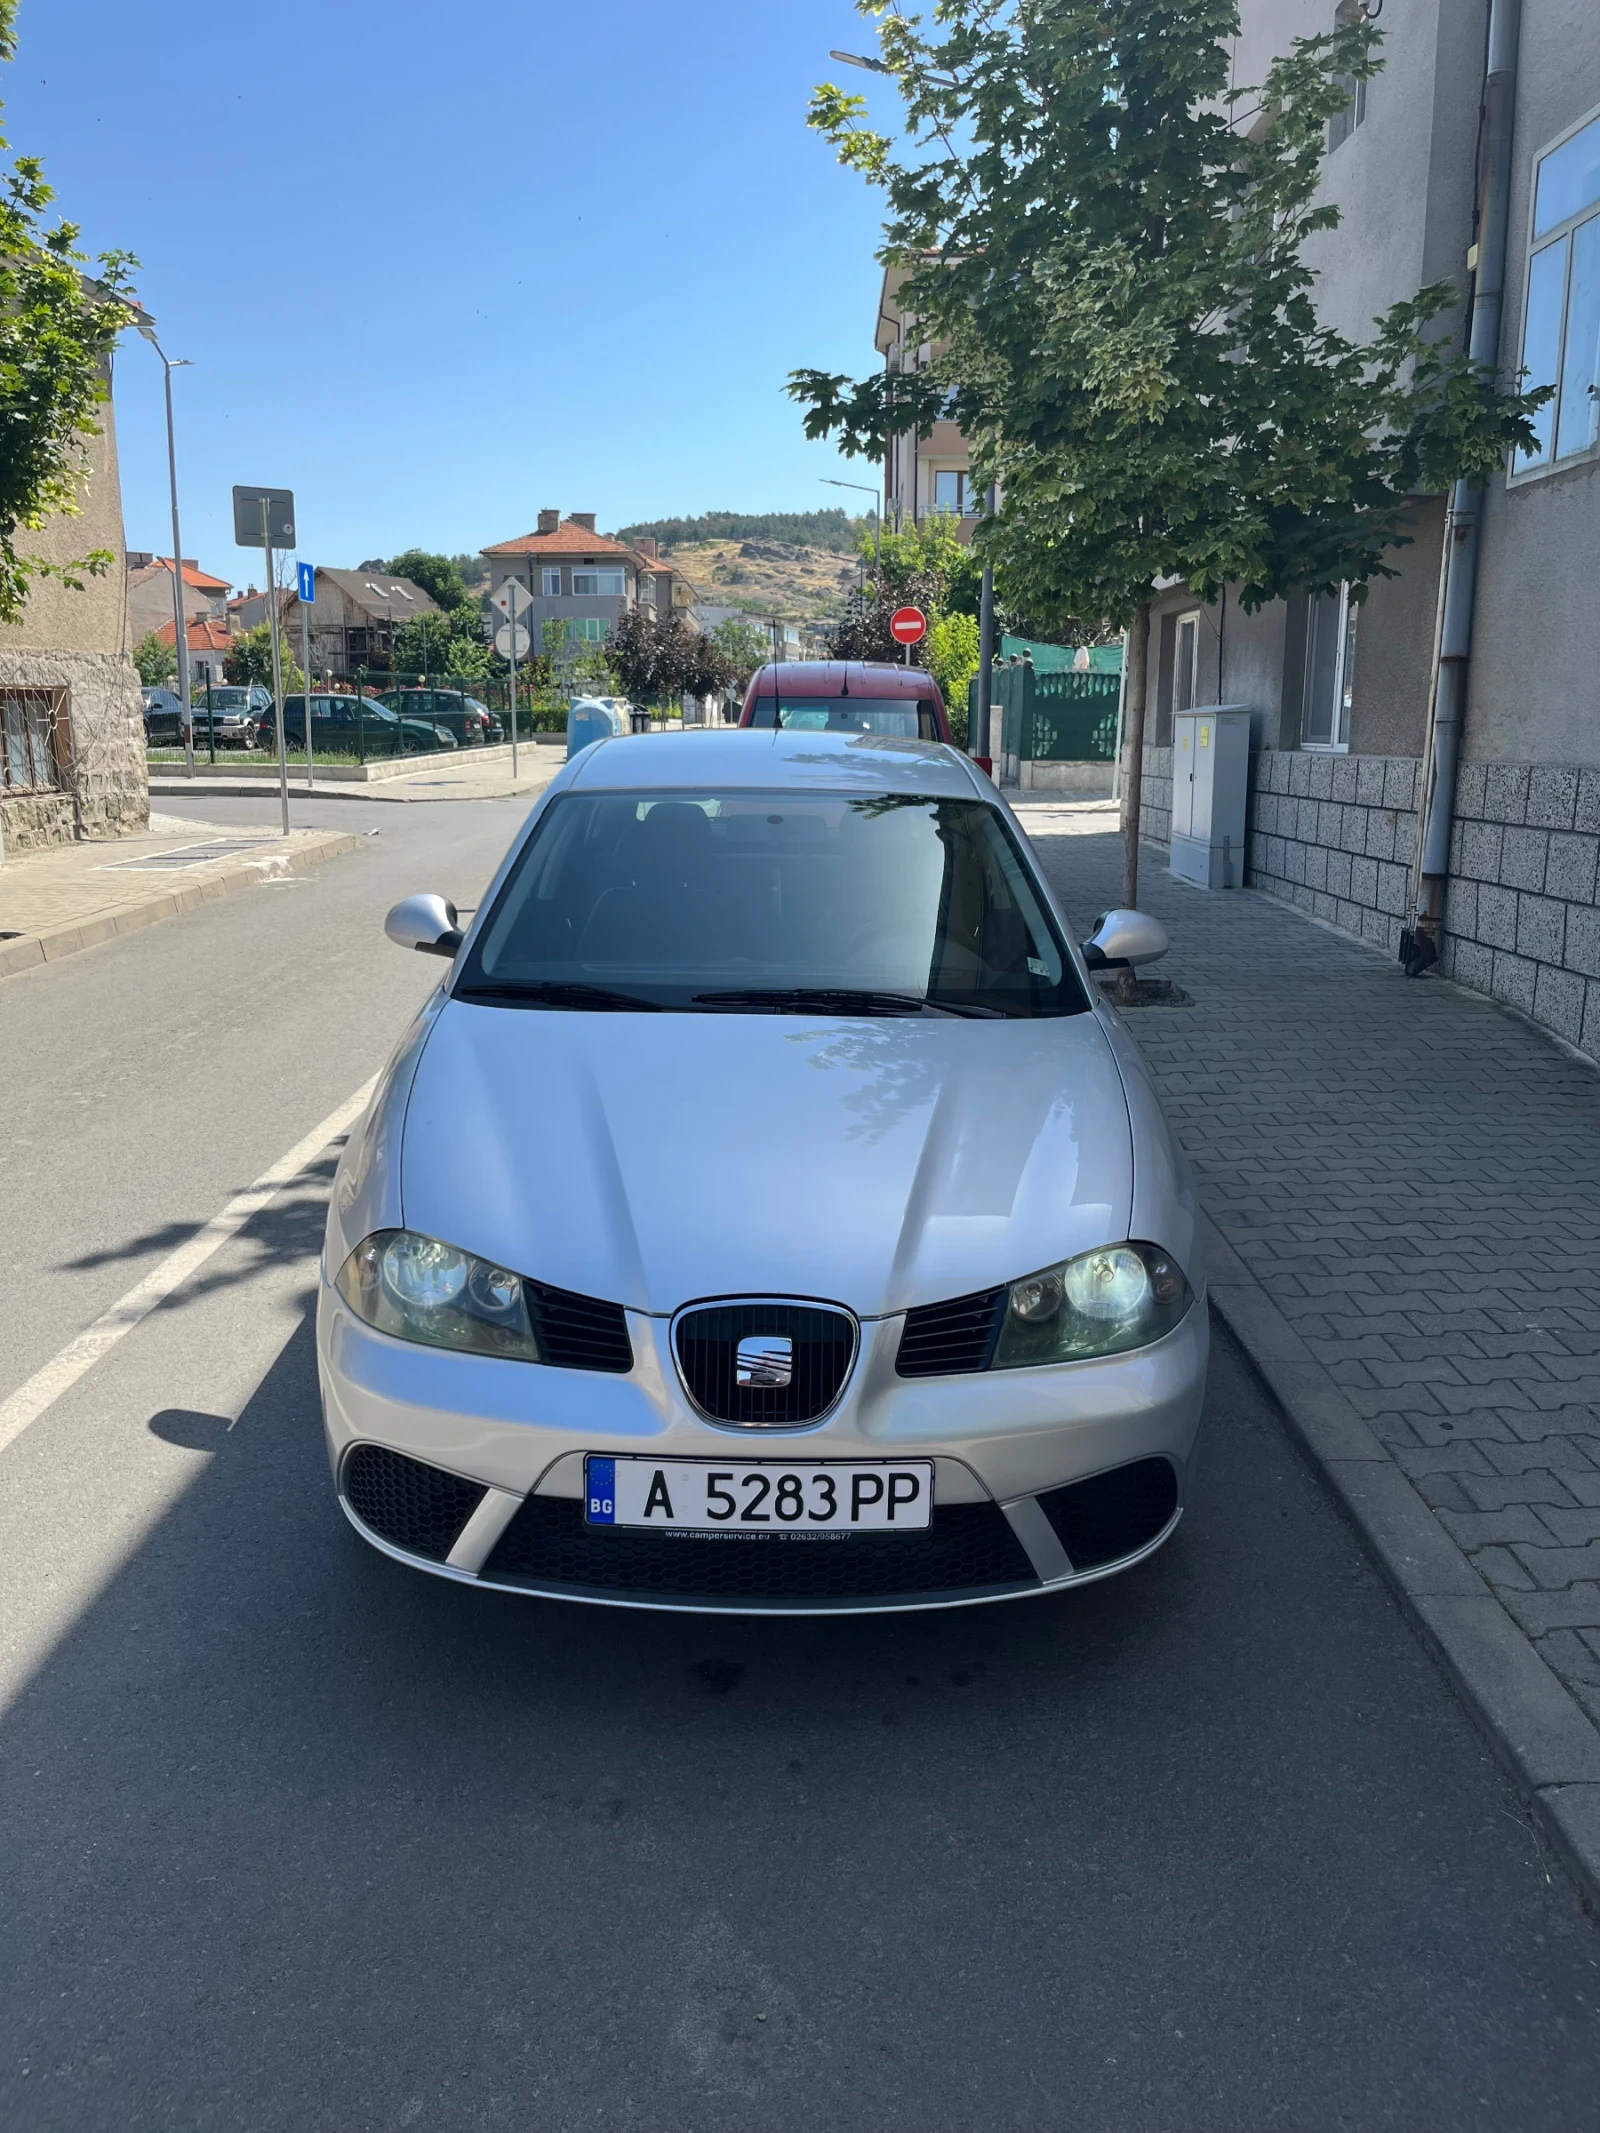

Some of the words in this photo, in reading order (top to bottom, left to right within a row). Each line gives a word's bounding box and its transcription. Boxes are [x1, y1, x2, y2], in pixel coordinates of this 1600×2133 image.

[643, 1470, 675, 1519] A
[706, 1473, 838, 1521] 5283
[851, 1473, 920, 1521] PP
[590, 1499, 612, 1514] BG
[665, 1531, 770, 1541] www.camperservice.eu
